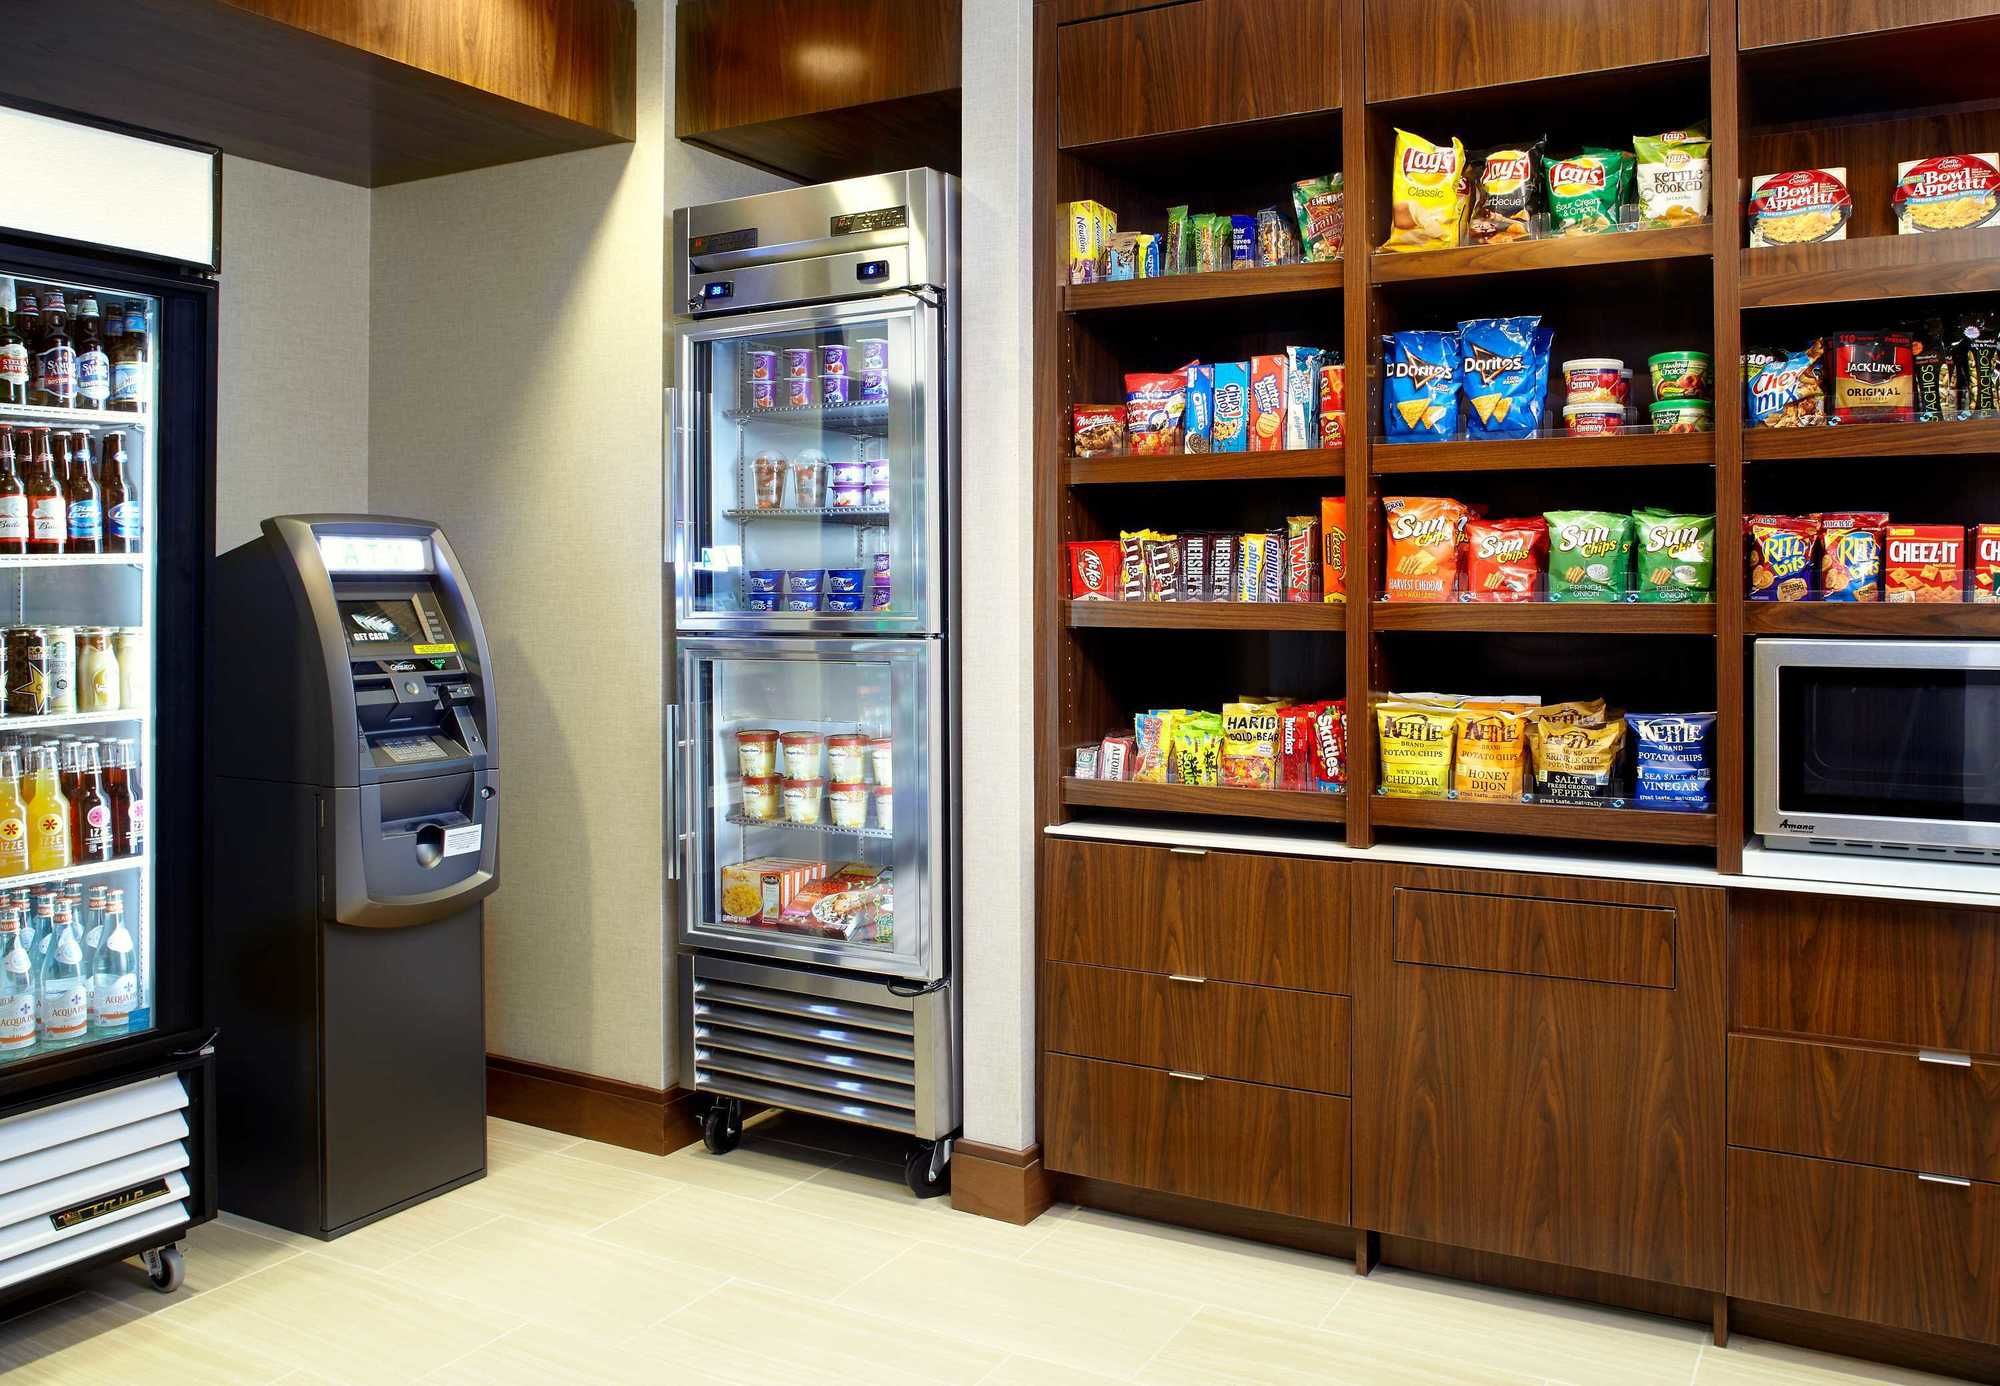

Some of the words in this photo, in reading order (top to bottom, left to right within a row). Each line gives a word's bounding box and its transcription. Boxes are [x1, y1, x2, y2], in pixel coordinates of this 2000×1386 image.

[1923, 167, 1971, 185] Bowl
[1407, 186, 1444, 198] Classic
[1775, 182, 1819, 200] Bowl
[1076, 216, 1088, 254] Newtons
[1396, 363, 1453, 380] Doritos
[1464, 357, 1522, 373] Doritos
[1844, 362, 1871, 373] JACK
[1263, 374, 1280, 409] Nutter
[1571, 381, 1596, 390] CHUNKY
[1846, 387, 1901, 397] ORIGINAL
[1223, 383, 1240, 414] Chips
[1254, 381, 1273, 415] Butter
[1191, 392, 1205, 430] OREO
[1392, 513, 1446, 540] Sun
[1560, 525, 1610, 552] Sun
[1647, 525, 1699, 552] Sun
[1478, 535, 1524, 559] Sun
[1582, 539, 1617, 558] Chips
[1763, 536, 1805, 563] RITZ
[1889, 541, 1959, 563] CHEEZ-IT
[1289, 527, 1310, 589] TWIX
[1496, 550, 1530, 564] Chips
[1772, 556, 1806, 577] bits
[1572, 590, 1600, 598] ONION
[368, 632, 389, 641] CASH
[1384, 714, 1443, 742] KETTLE
[1463, 715, 1520, 743] KETTLE
[1637, 718, 1704, 744] KETTLE
[1317, 713, 1340, 778] Skittles
[1400, 740, 1425, 748] BRAND
[1383, 749, 1416, 758] POTATO
[1417, 750, 1443, 758] CHIPS
[1462, 751, 1495, 761] POTATO
[1496, 753, 1519, 761] CHIPS
[1638, 751, 1675, 762] POTATO
[1677, 753, 1703, 762] CHIPS
[1385, 774, 1439, 787] CHEDDAR
[1468, 769, 1510, 781] HONEY
[1554, 775, 1580, 784] SALT
[1580, 776, 1588, 784] &
[1663, 773, 1688, 781] SALT
[1471, 780, 1506, 793] DIJON
[1551, 788, 1592, 799] PEPPER
[1642, 781, 1700, 792] VINEGAR
[1779, 818, 1815, 831] Amana
[105, 993, 130, 1004] ACQUA
[51, 1006, 76, 1017] ACQUA
[1, 1015, 27, 1027] ACQUA
